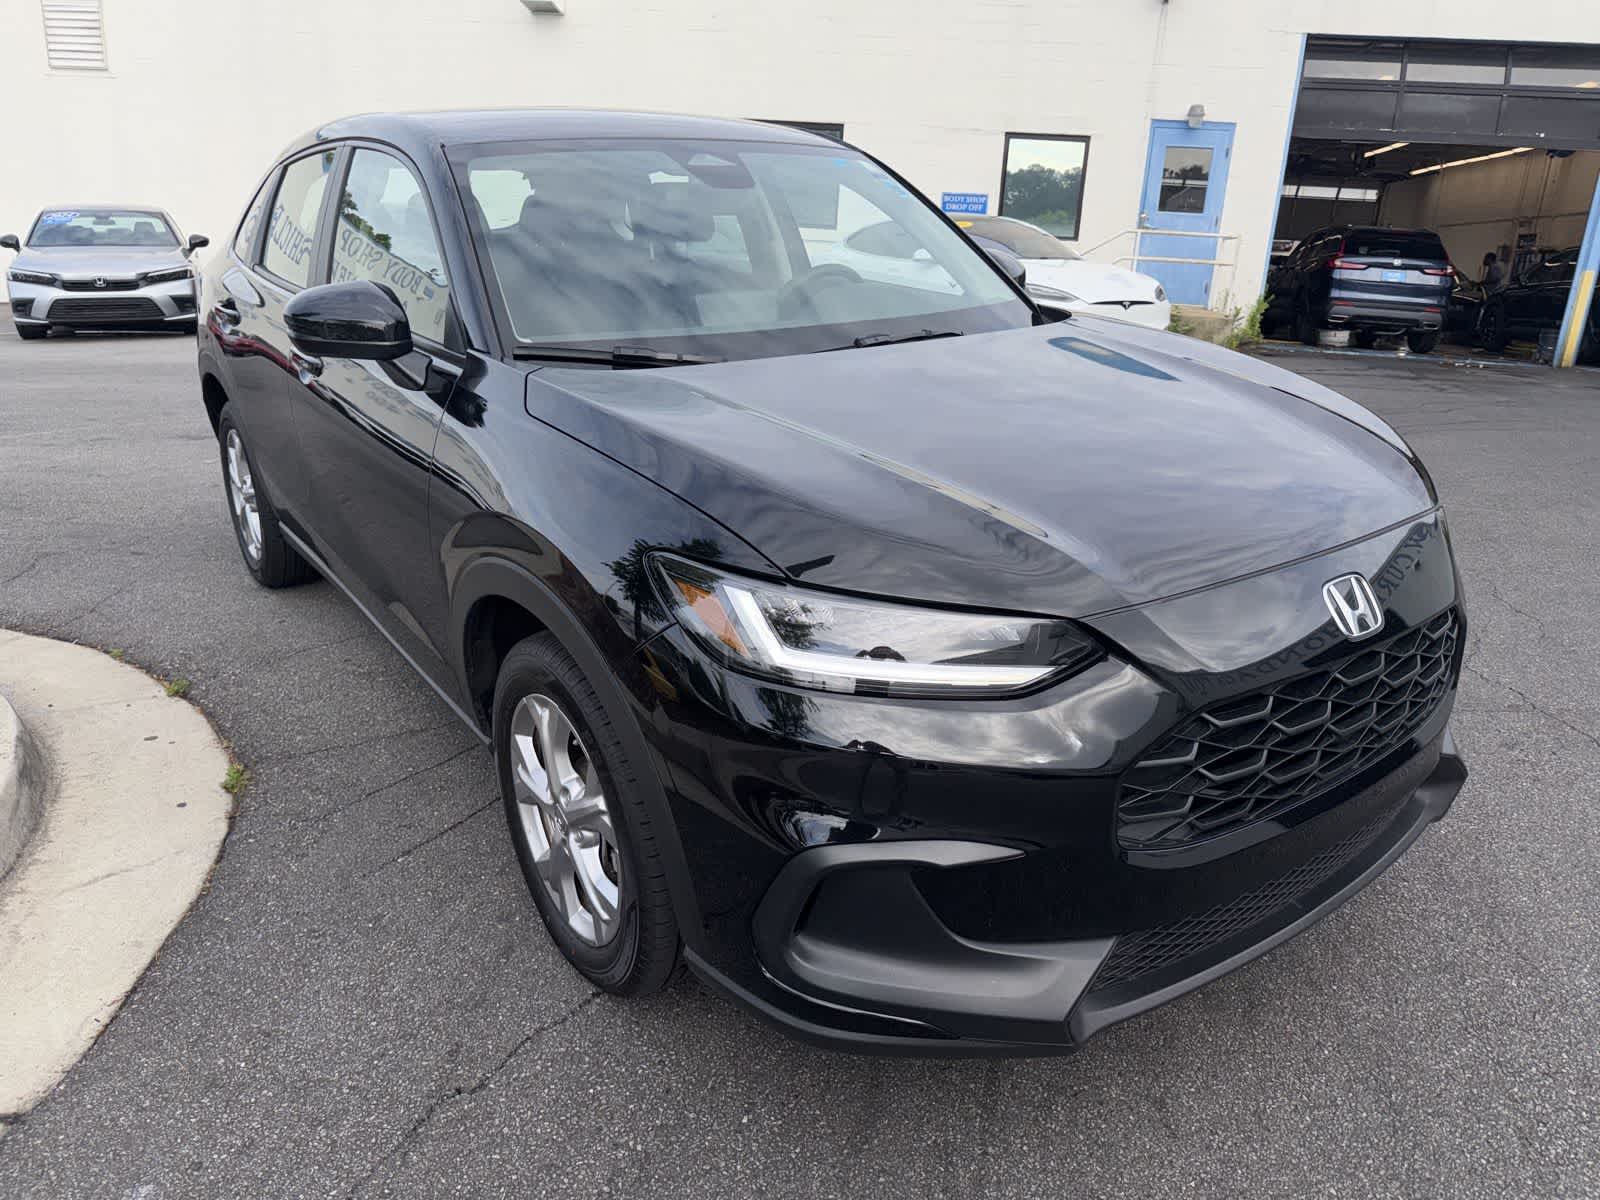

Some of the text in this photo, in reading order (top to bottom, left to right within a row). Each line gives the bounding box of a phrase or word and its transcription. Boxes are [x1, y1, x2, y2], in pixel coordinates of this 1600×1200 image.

[943, 195, 987, 204] BODY SHOP
[945, 202, 985, 212] DROP OFF
